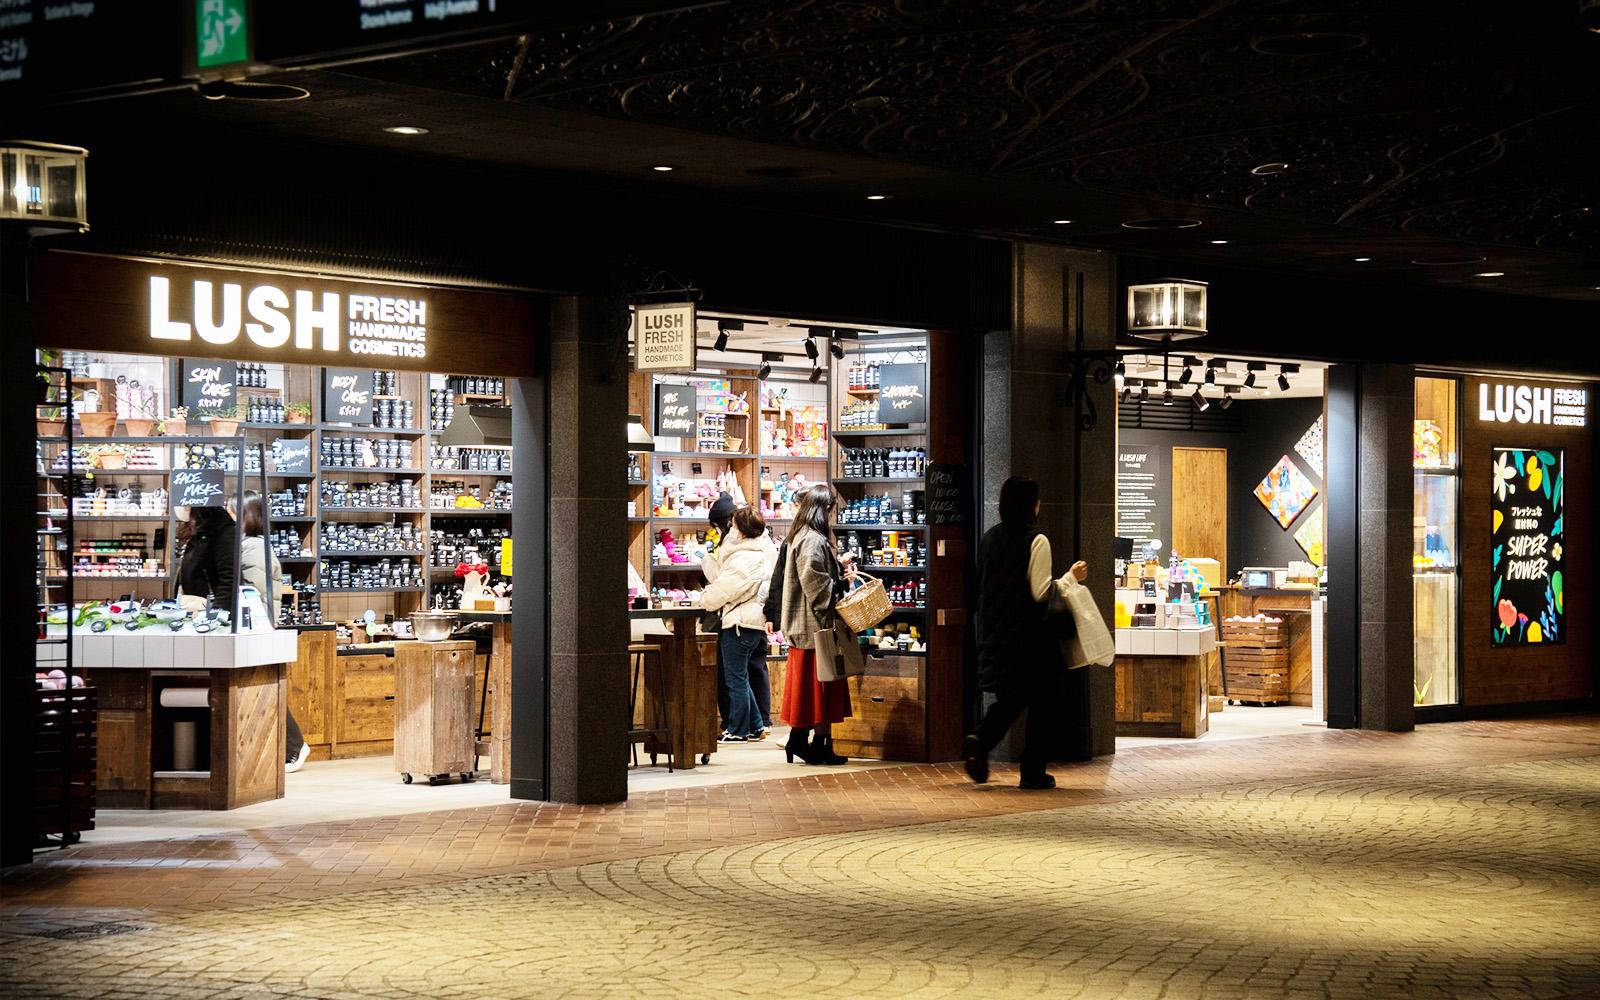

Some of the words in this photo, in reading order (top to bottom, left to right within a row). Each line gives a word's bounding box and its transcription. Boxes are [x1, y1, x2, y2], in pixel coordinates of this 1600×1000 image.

[149, 275, 340, 351] LUSH
[348, 294, 427, 326] FRESH
[645, 313, 684, 330] LUSH
[348, 321, 426, 342] HANDMADE
[645, 330, 684, 344] FRESH
[348, 338, 426, 358] COSMETICS
[645, 345, 683, 354] HANDMADE
[645, 354, 683, 363] COSMETICS
[188, 366, 222, 383] SKIN
[200, 382, 233, 397] CARE
[331, 375, 358, 391] BODY
[881, 384, 923, 398] SHOWER
[341, 390, 369, 405] CARE
[1479, 383, 1552, 425] LUSH
[1553, 388, 1586, 405] FRESH
[173, 471, 203, 485] FACE
[930, 471, 953, 484] OPEN
[183, 482, 224, 497] MASKS
[1511, 506, 1543, 517] フレッシュな
[1506, 533, 1549, 557] SUPER
[1506, 557, 1549, 580] POWER
